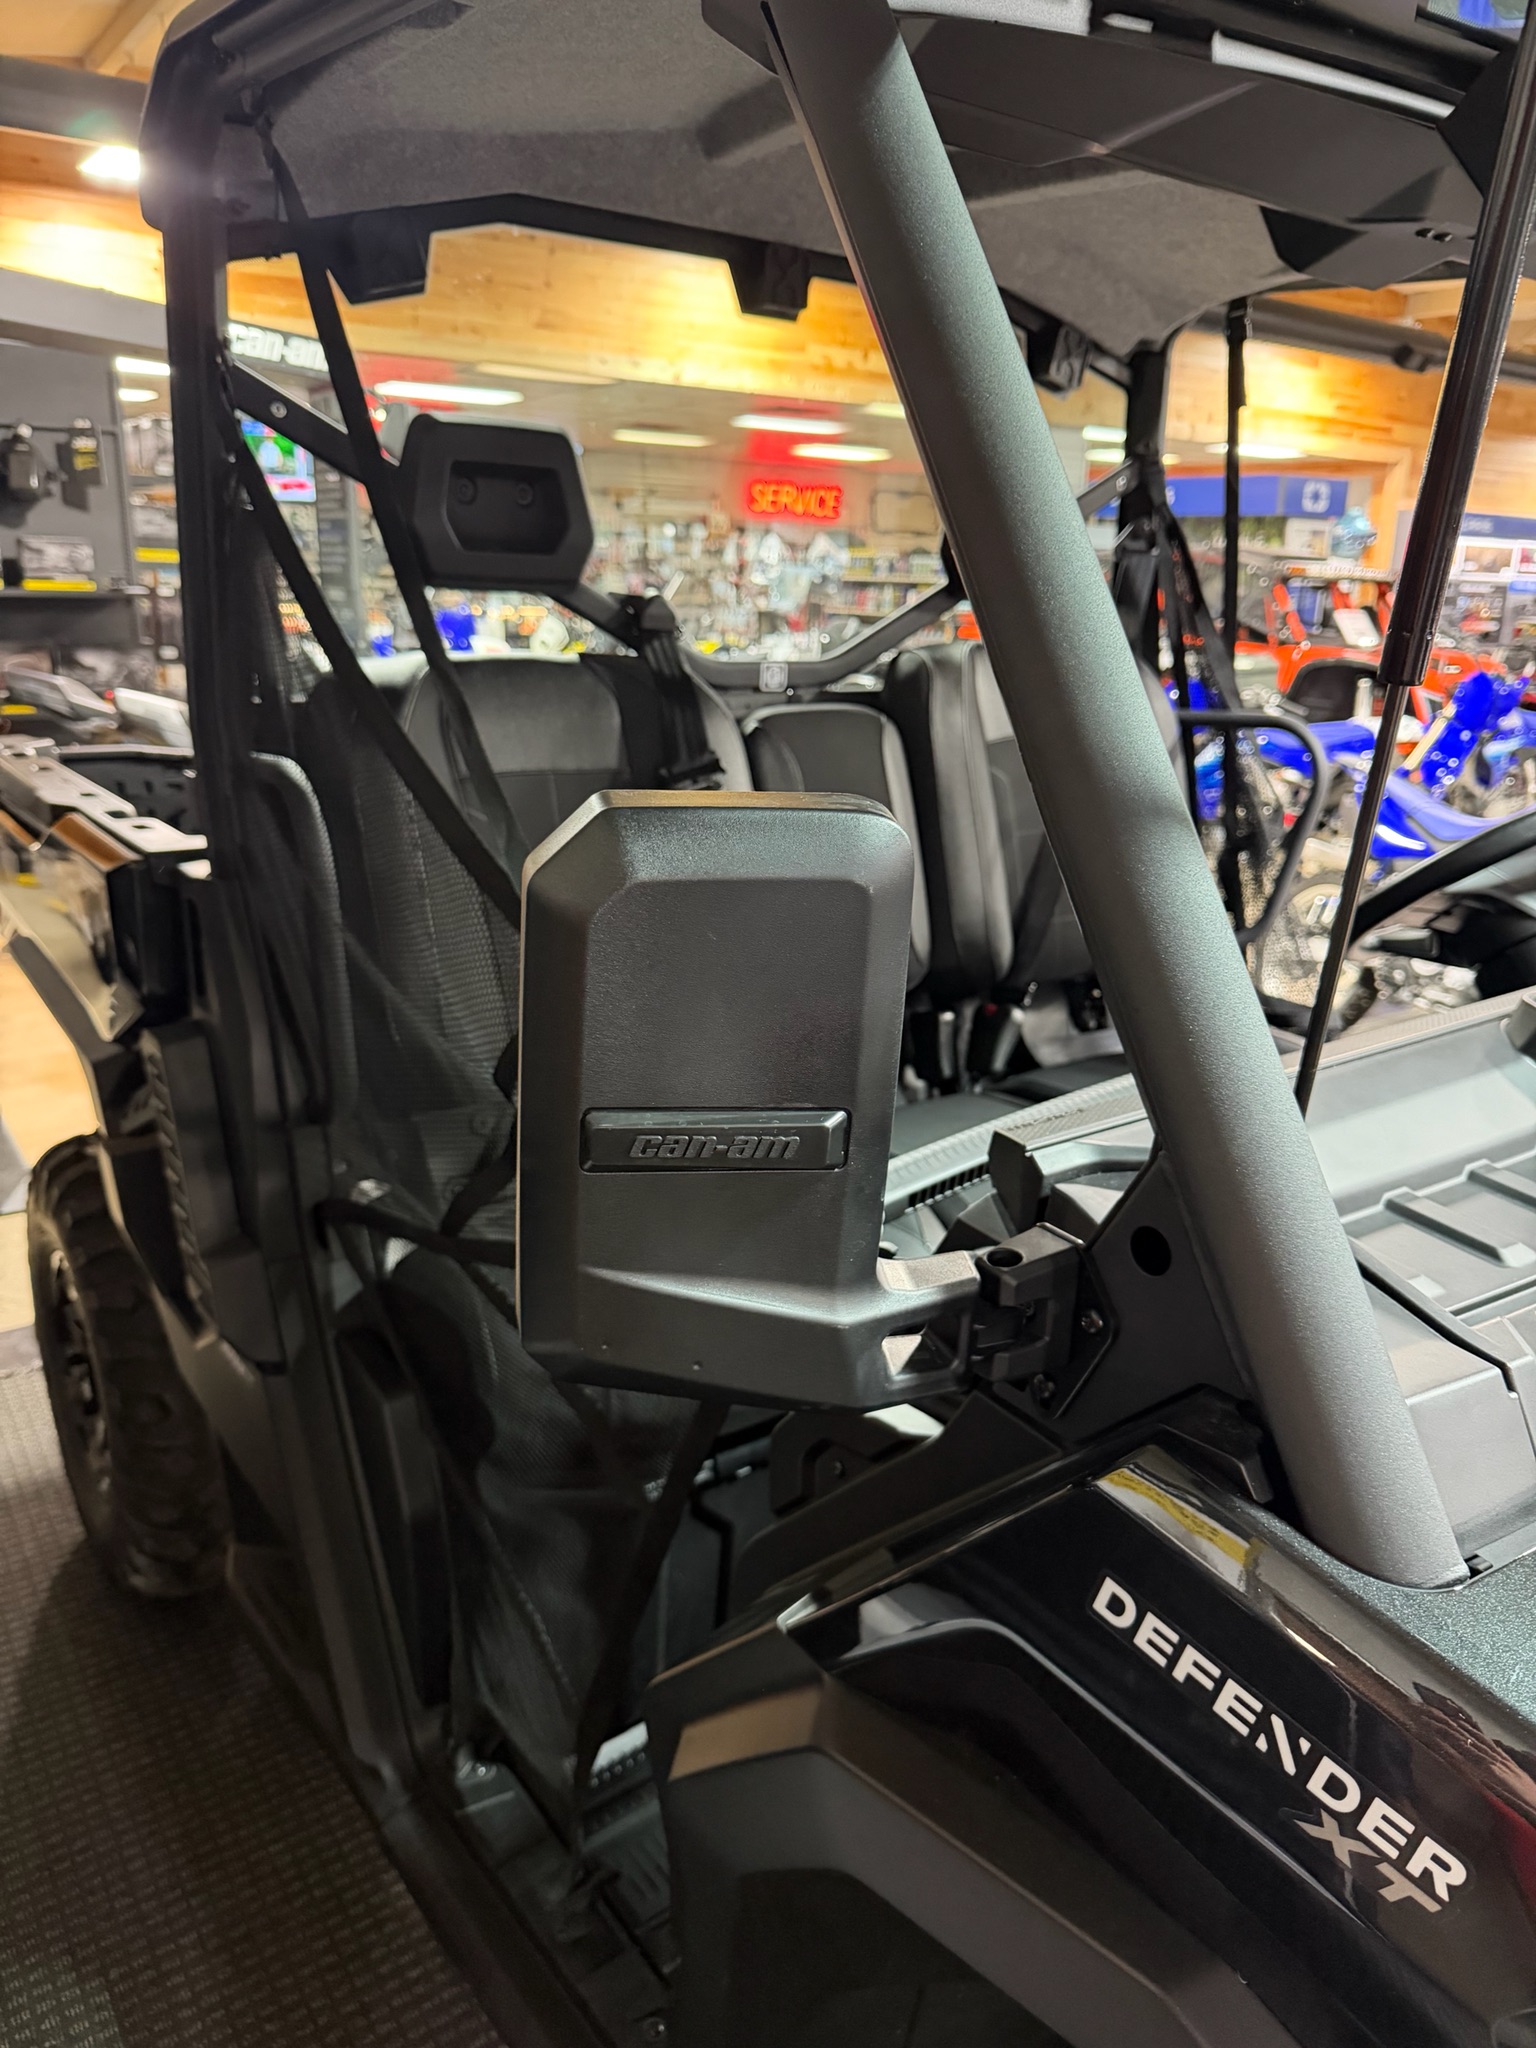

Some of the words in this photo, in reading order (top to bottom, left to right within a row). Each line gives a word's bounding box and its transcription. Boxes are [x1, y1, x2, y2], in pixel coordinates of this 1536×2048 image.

[748, 480, 843, 519] SERVICE
[628, 1134, 801, 1160] can-am
[1091, 1575, 1468, 1903] DEFENDER
[1292, 1807, 1443, 1914] XT
